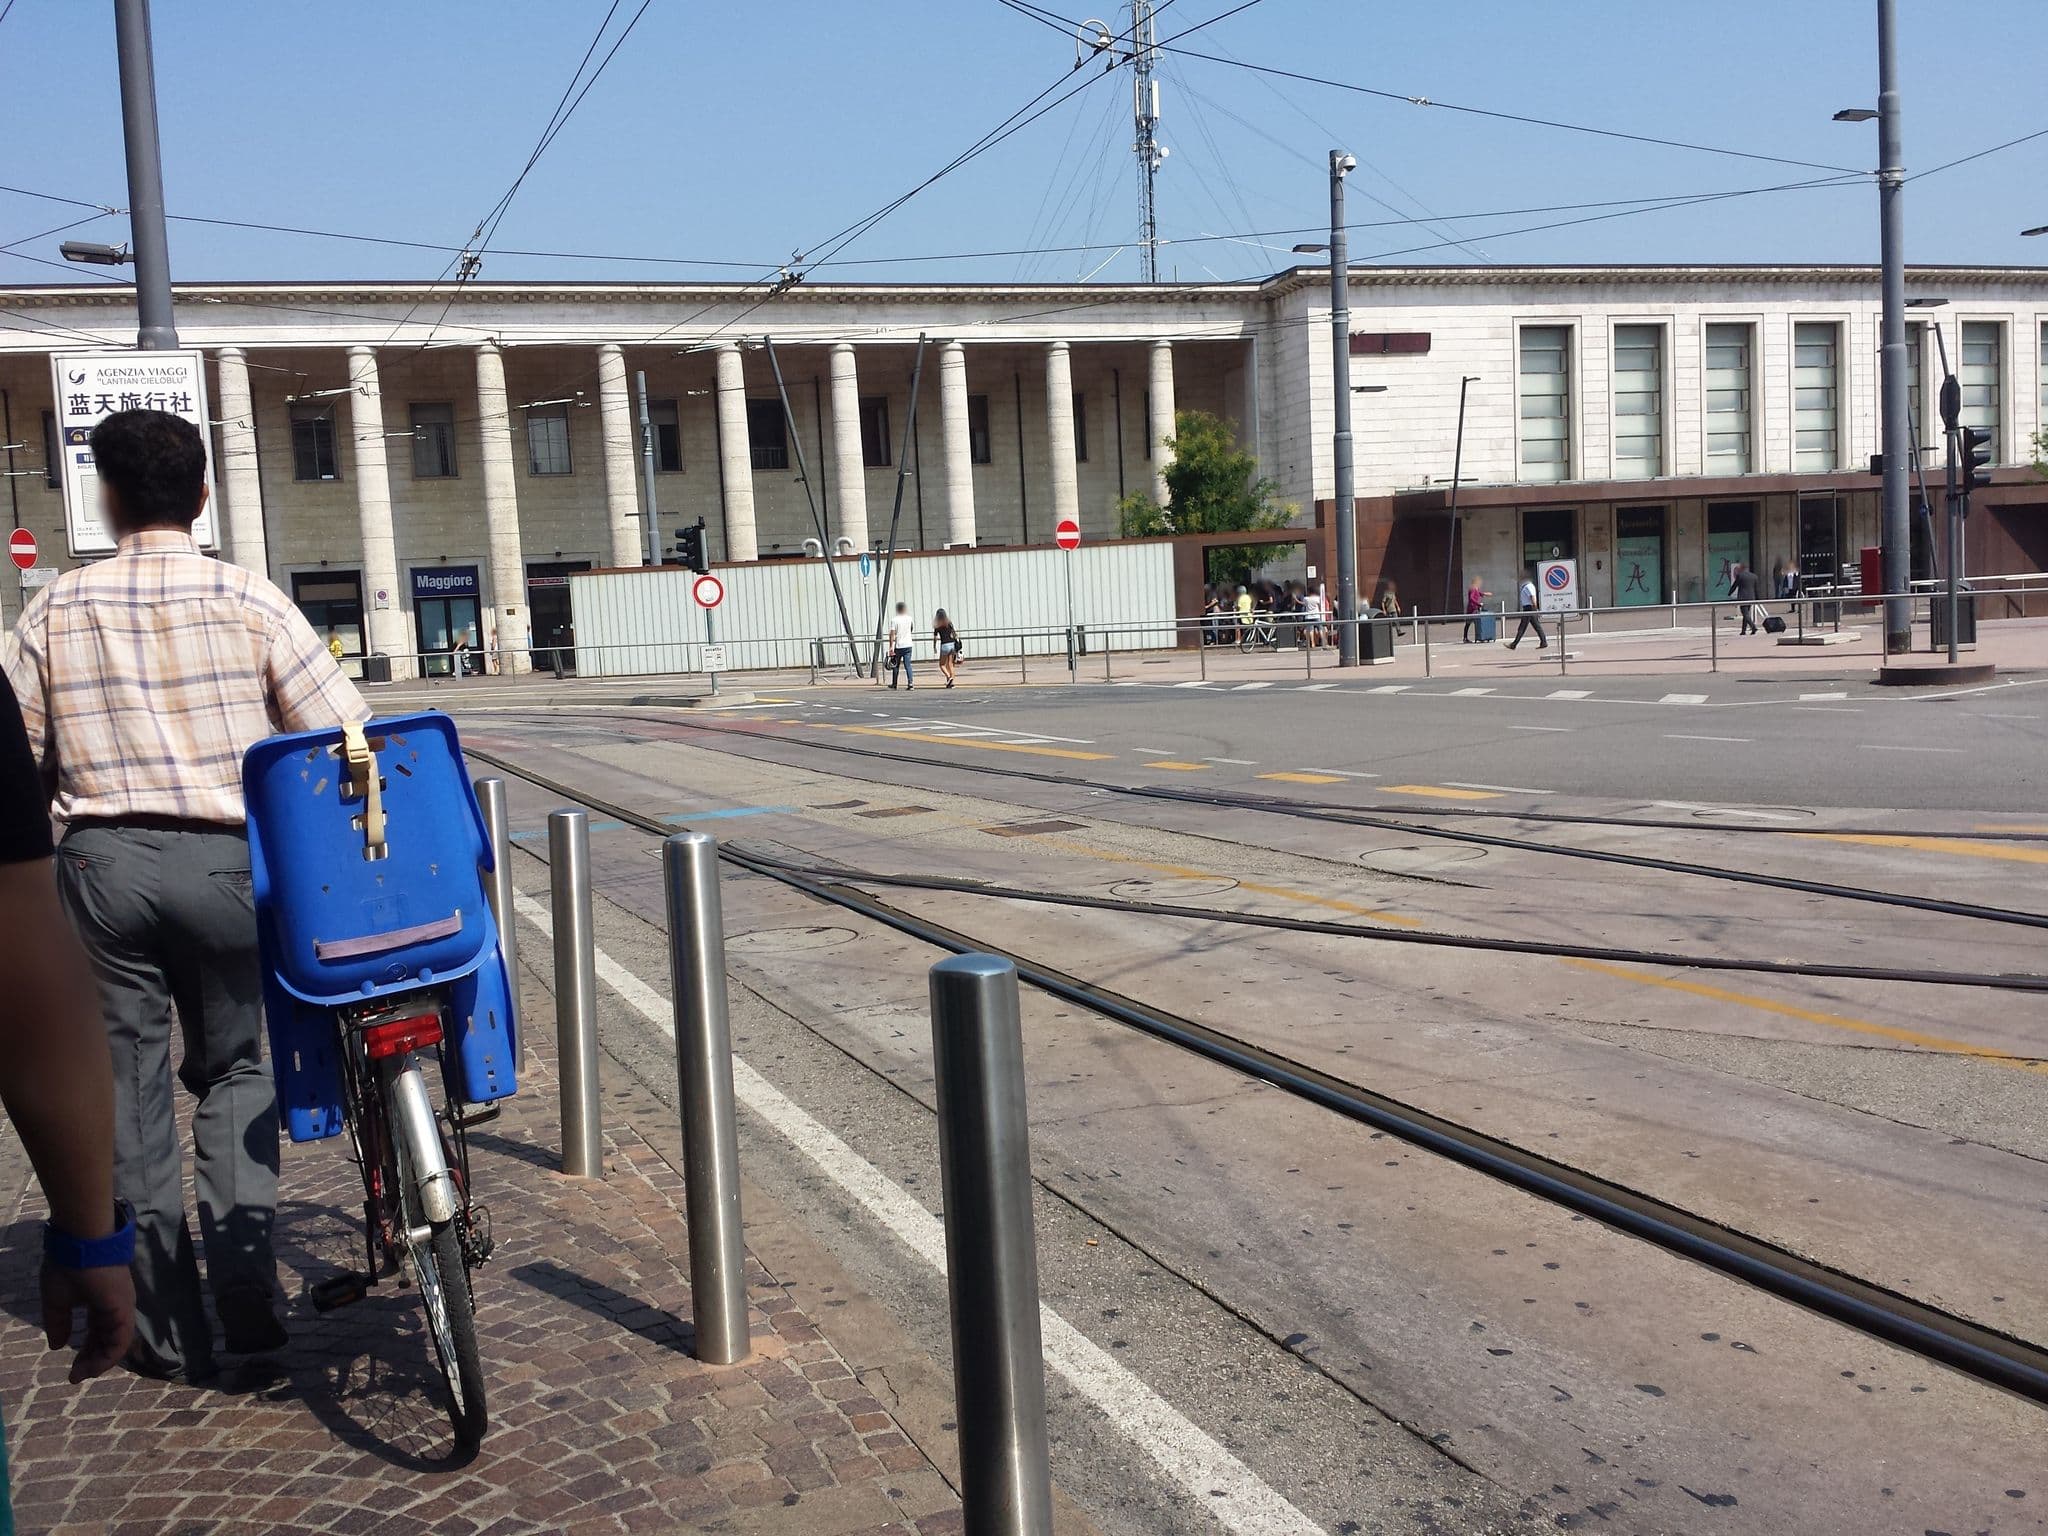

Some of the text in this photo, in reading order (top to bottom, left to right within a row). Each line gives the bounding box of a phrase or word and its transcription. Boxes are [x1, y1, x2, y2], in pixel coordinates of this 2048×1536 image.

[97, 367, 187, 377] AGENZIA VIAGGI
[67, 391, 194, 416] 蓝天旅行社
[416, 574, 473, 590] Maggiore
